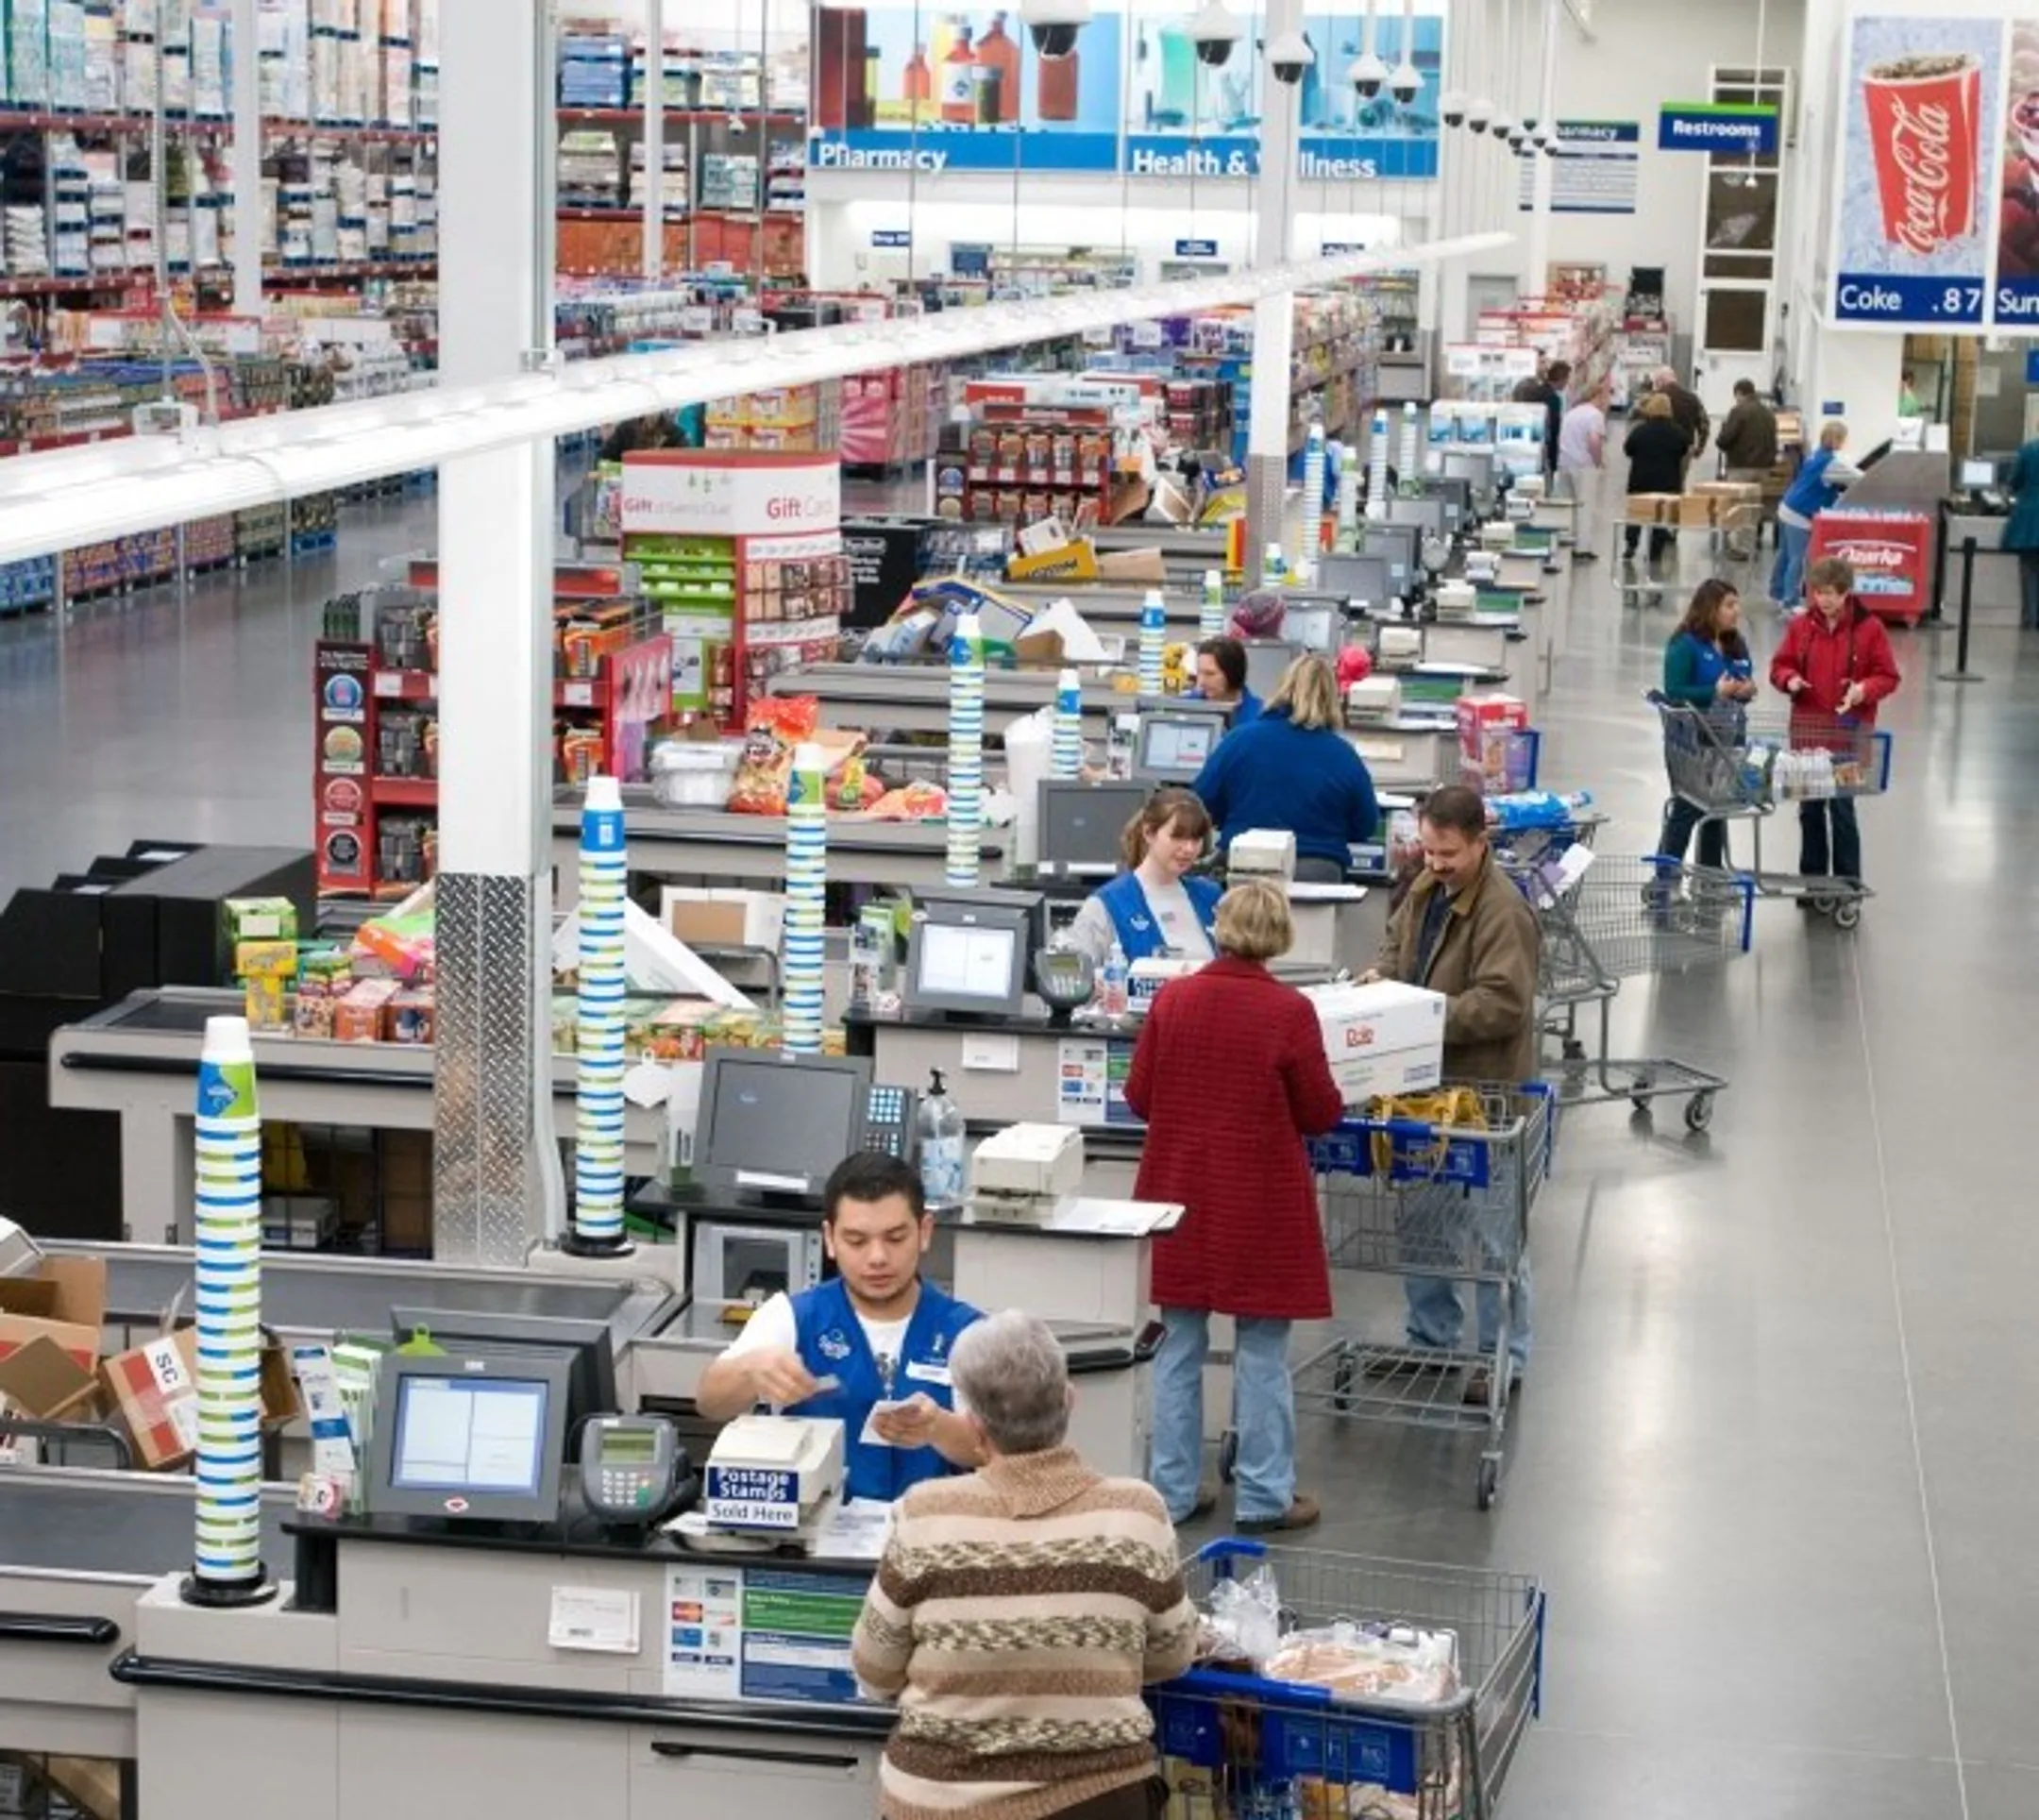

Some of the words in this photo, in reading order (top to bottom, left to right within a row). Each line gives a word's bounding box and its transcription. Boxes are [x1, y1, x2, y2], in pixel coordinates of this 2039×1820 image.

[1673, 120, 1761, 138] Restrooms
[818, 143, 948, 174] Pharmacy
[1133, 149, 1220, 175] Health
[1226, 150, 1249, 176] &
[1840, 285, 1902, 311] Coke
[1931, 287, 1981, 313] .87
[623, 497, 652, 514] Gift
[767, 497, 801, 520] Gift
[716, 1469, 790, 1489] Postage
[719, 1483, 787, 1502] Stamps
[712, 1503, 750, 1519] Sold
[753, 1505, 794, 1523] Here
